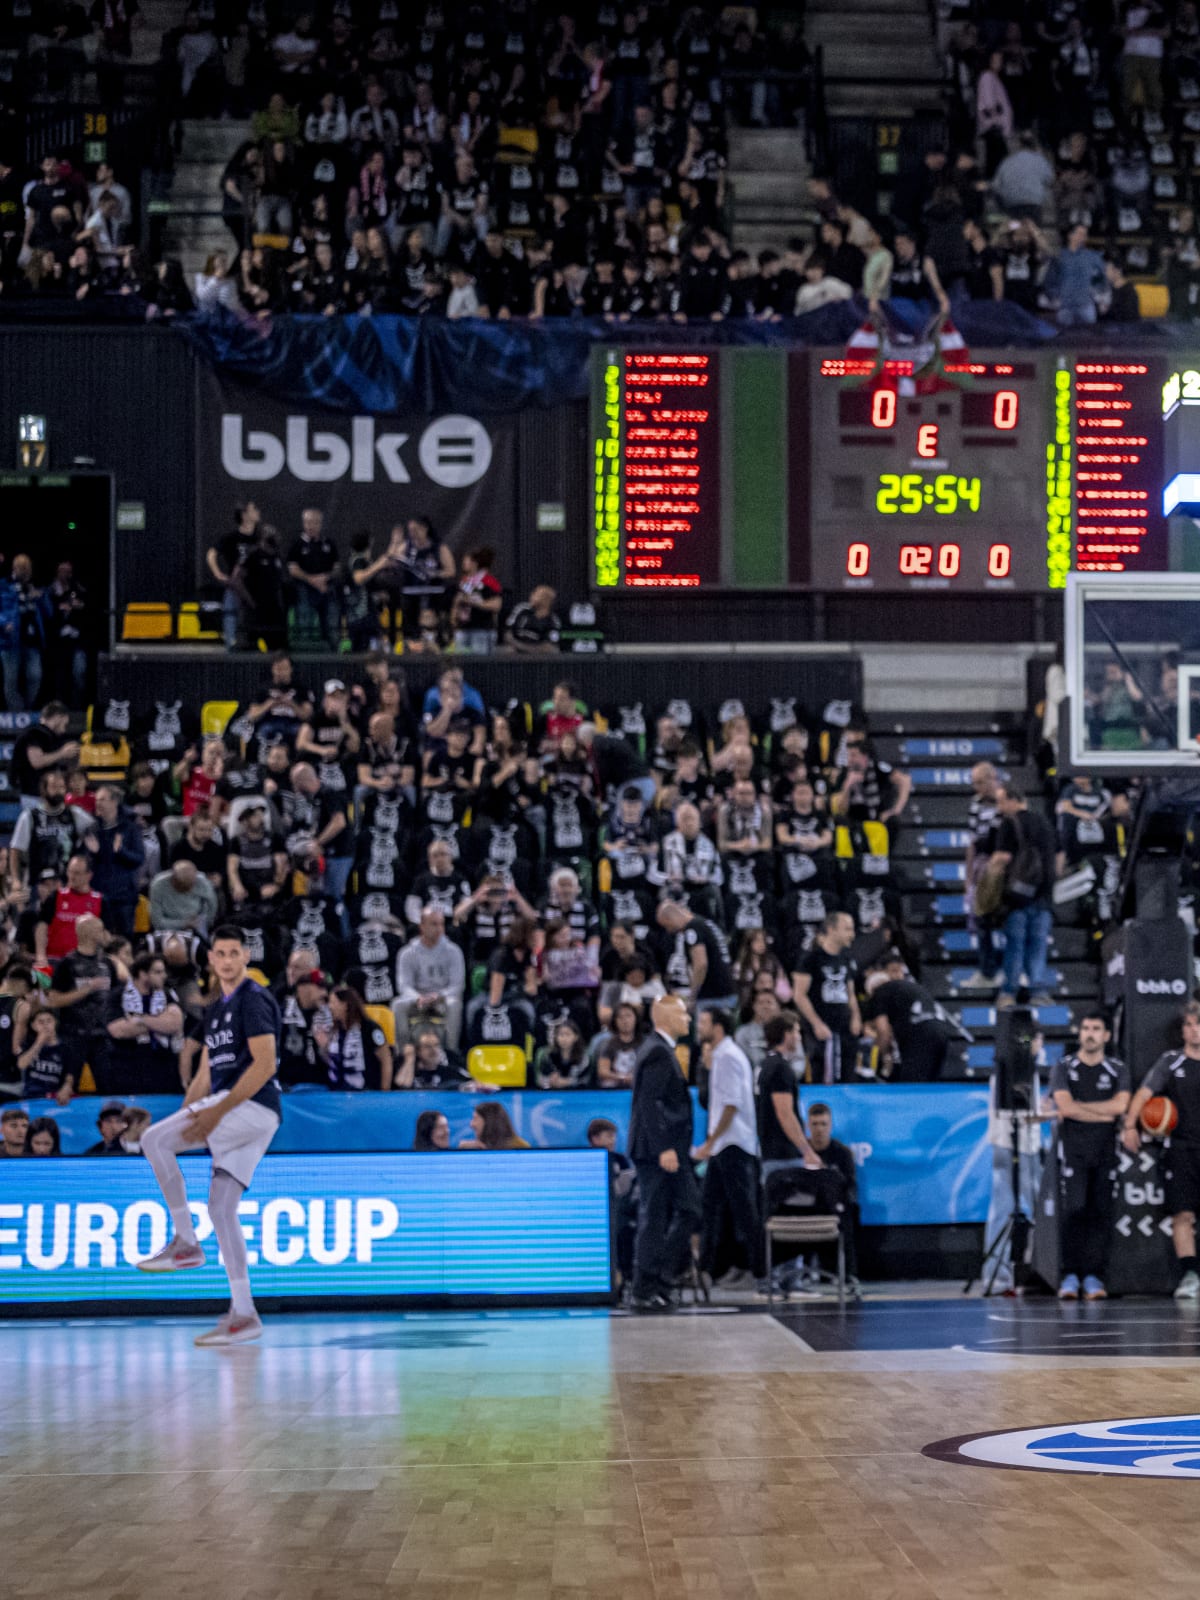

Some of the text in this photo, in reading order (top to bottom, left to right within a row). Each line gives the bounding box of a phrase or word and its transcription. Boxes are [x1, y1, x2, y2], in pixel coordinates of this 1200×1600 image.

[871, 389, 897, 428] 0
[993, 390, 1019, 429] 0
[21, 442, 46, 468] 17
[221, 413, 411, 483] bbk
[917, 424, 939, 458] E
[875, 473, 982, 514] 25:54
[847, 542, 870, 576] 0
[988, 543, 1011, 577] 0
